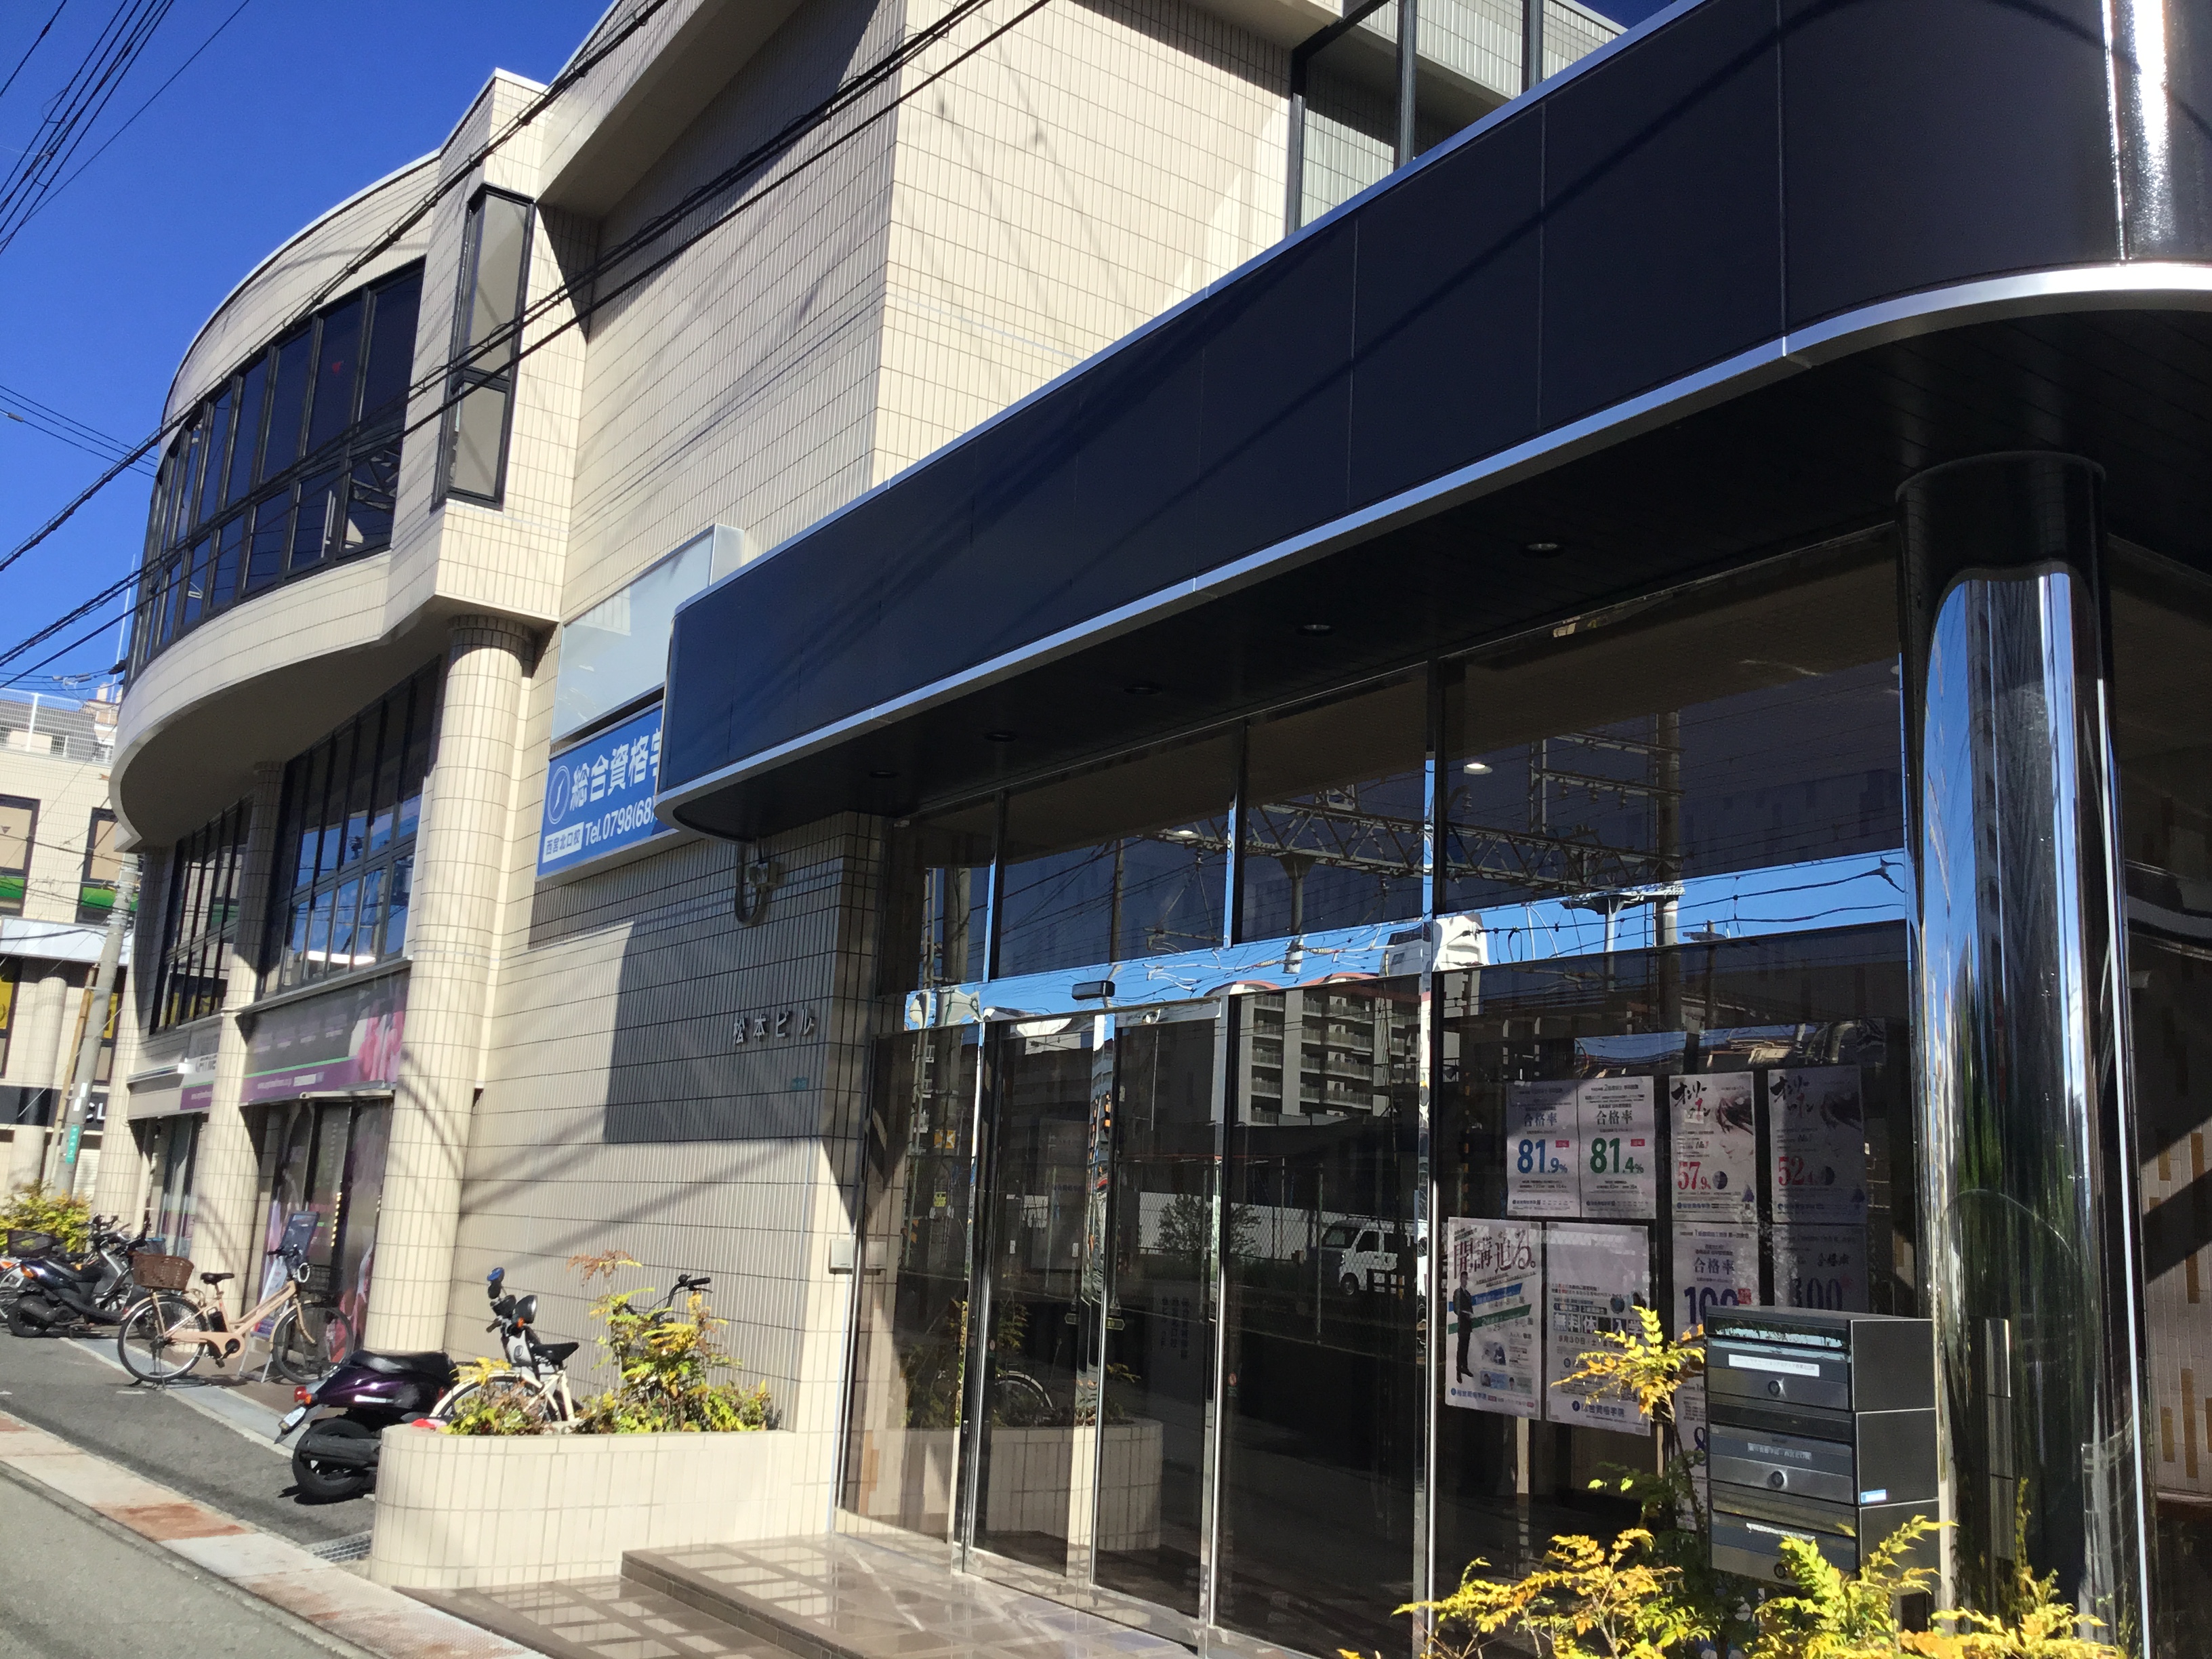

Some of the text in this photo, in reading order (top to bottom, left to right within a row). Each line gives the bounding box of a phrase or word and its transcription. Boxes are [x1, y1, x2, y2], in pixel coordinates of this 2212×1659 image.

[546, 828, 581, 856] 西宮北口校
[733, 1008, 815, 1045] 松本ビル
[1523, 1109, 1557, 1128] 合格率
[1595, 1109, 1633, 1126] 合格率
[1517, 1139, 1568, 1174] 81.9%
[1589, 1137, 1645, 1174] 81.4%
[1694, 1256, 1735, 1275] 合格率
[1553, 1312, 1643, 1340] 無料体入学
